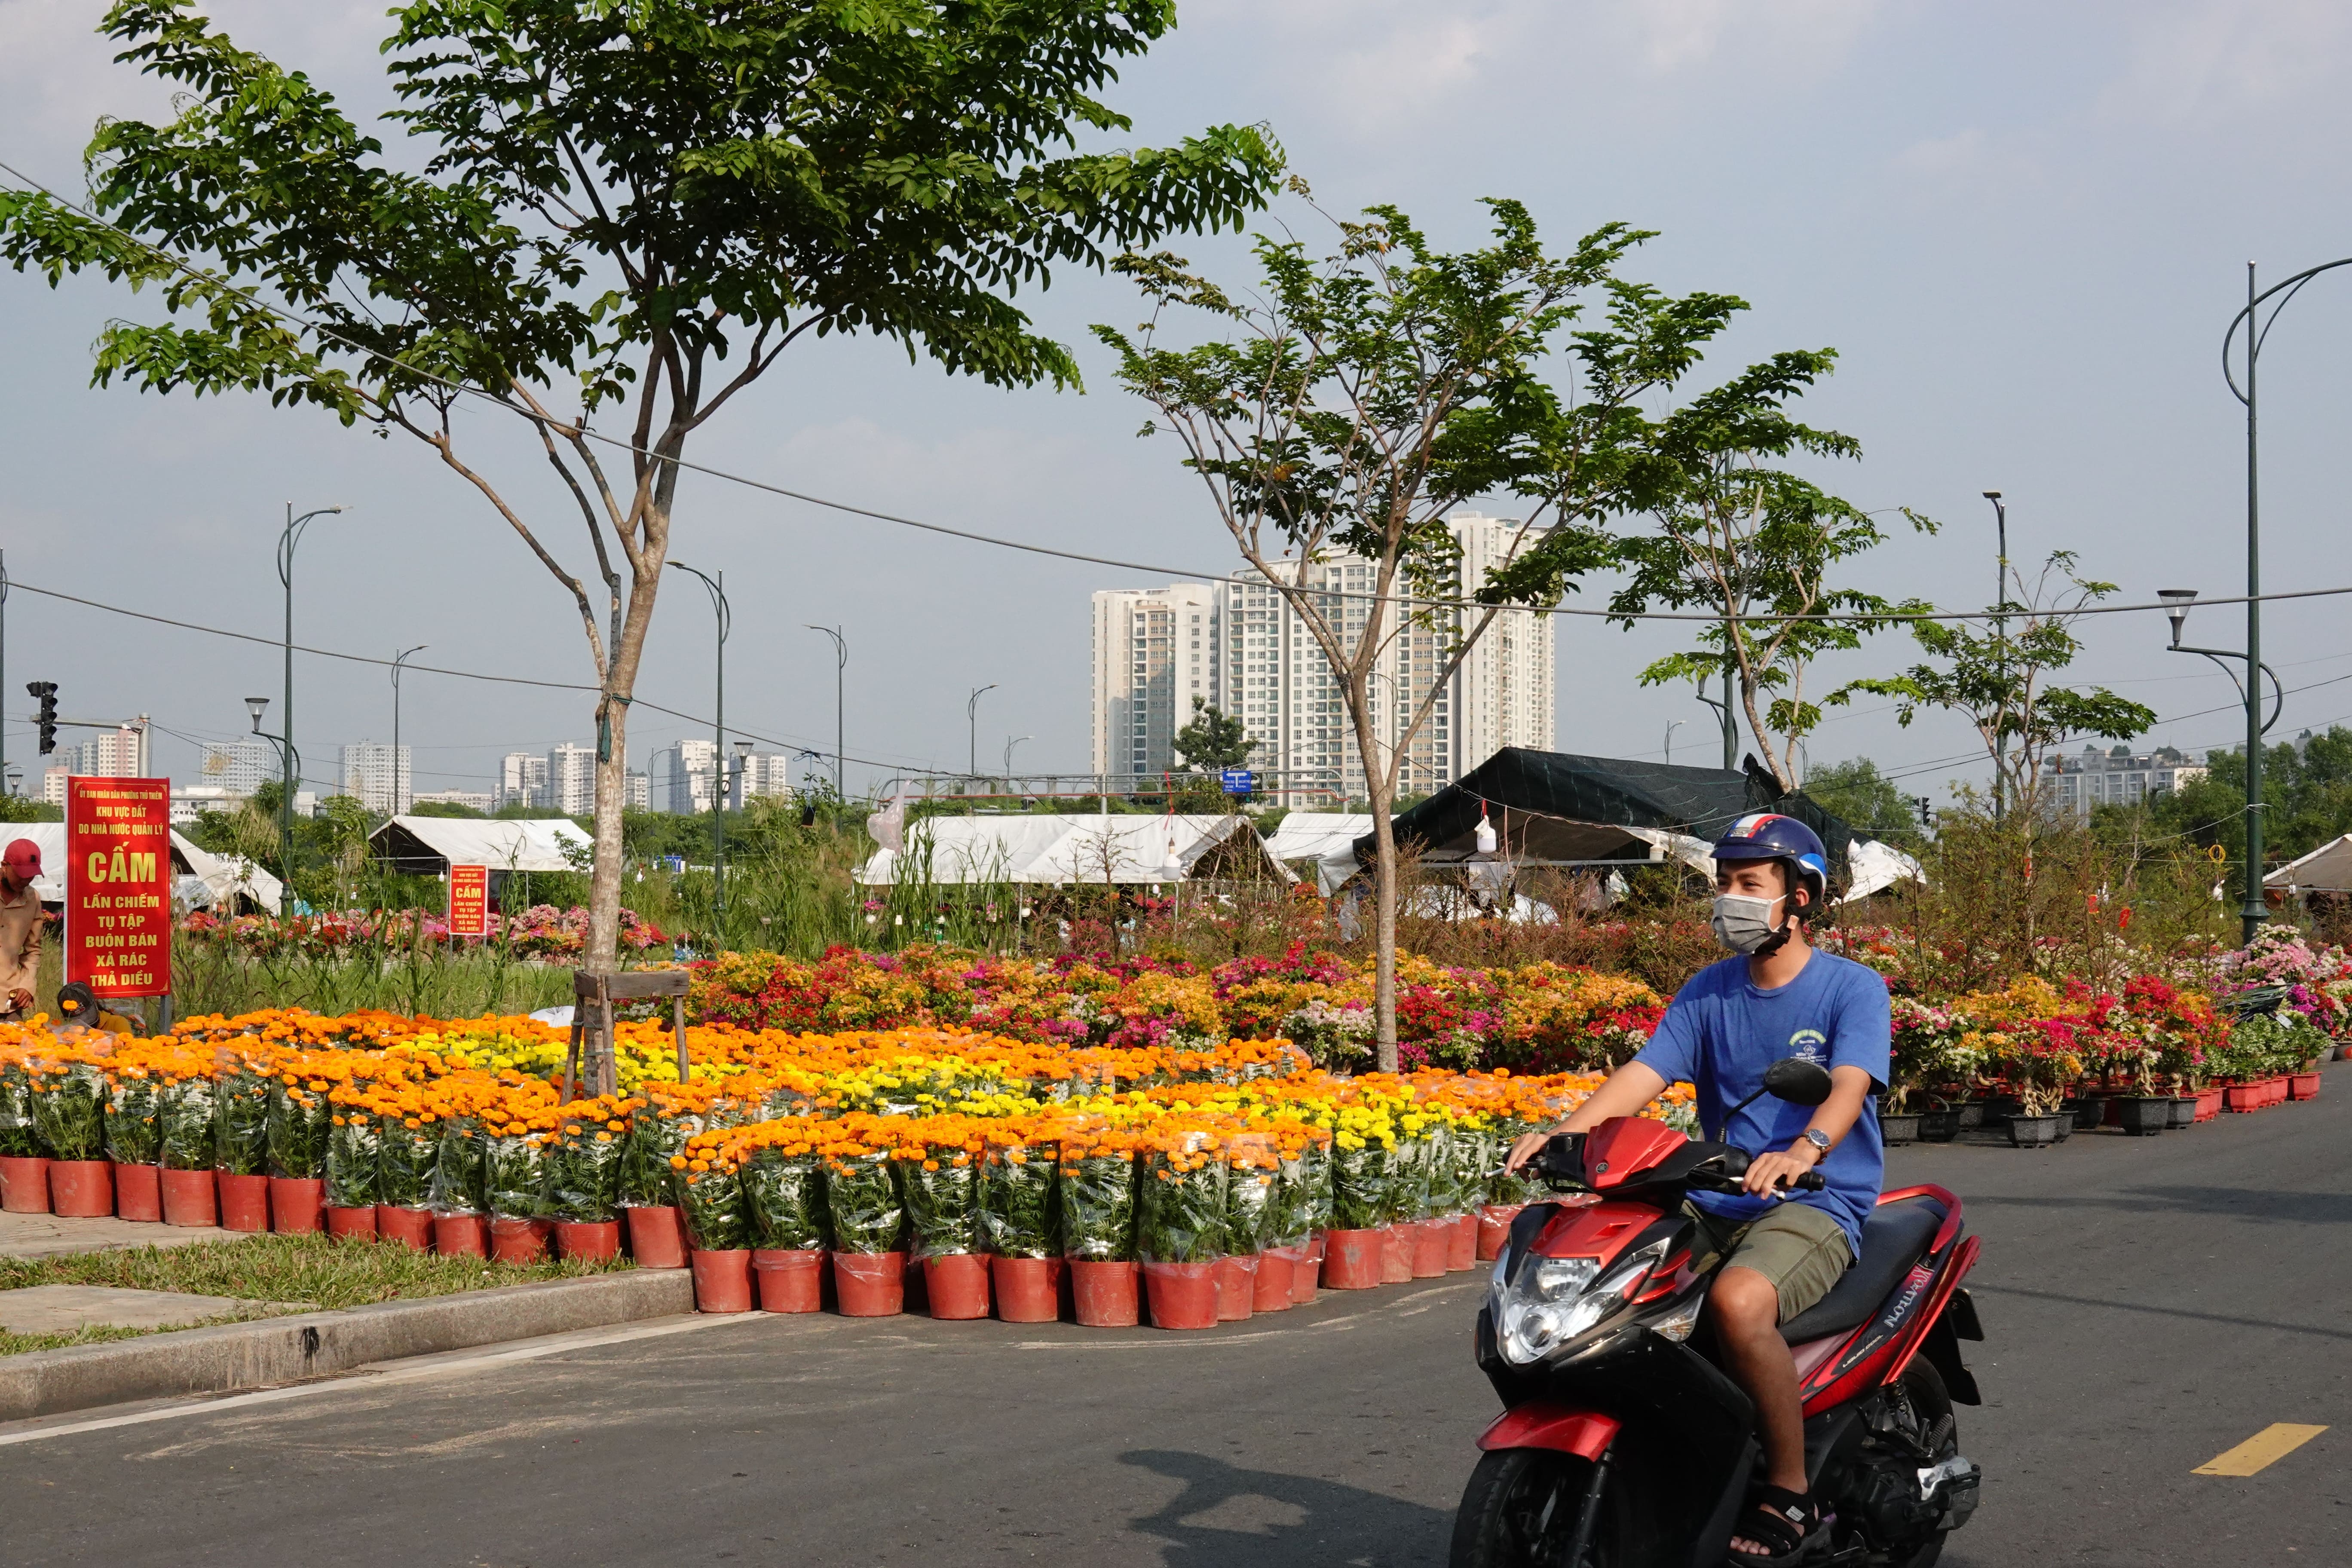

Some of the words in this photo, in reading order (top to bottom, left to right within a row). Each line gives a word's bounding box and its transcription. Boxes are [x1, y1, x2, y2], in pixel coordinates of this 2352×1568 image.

[97, 789, 110, 799] NHÂN
[111, 790, 119, 799] DÂN
[121, 790, 139, 799] PHƯỜNG
[149, 791, 162, 800] THIÊM
[96, 806, 112, 817] KHU
[114, 805, 129, 820] VỰC
[132, 803, 147, 818] ĐẤT
[78, 824, 89, 834] DO
[91, 822, 107, 835] NHÀ
[109, 822, 131, 835] NƯỚC
[132, 821, 153, 836] QUẢN
[155, 822, 163, 835] LÝ
[88, 841, 156, 883] CẤM
[456, 884, 481, 898] CẤM
[83, 892, 111, 908] LẤN
[115, 892, 159, 908] CHIẾM
[98, 916, 115, 930] TỤ
[119, 913, 145, 930] TẬP
[86, 933, 124, 948] BUÔN
[129, 932, 157, 946] BÁN
[96, 951, 115, 967] XẢ
[119, 952, 147, 966] RÁC
[90, 971, 117, 987] THẢ
[121, 970, 153, 986] DIỀU
[1883, 1279, 1923, 1328] NOUVO
[1911, 1265, 1932, 1282] SX
[1843, 1348, 1865, 1368] LIQUID
[1865, 1335, 1883, 1350] COOL
